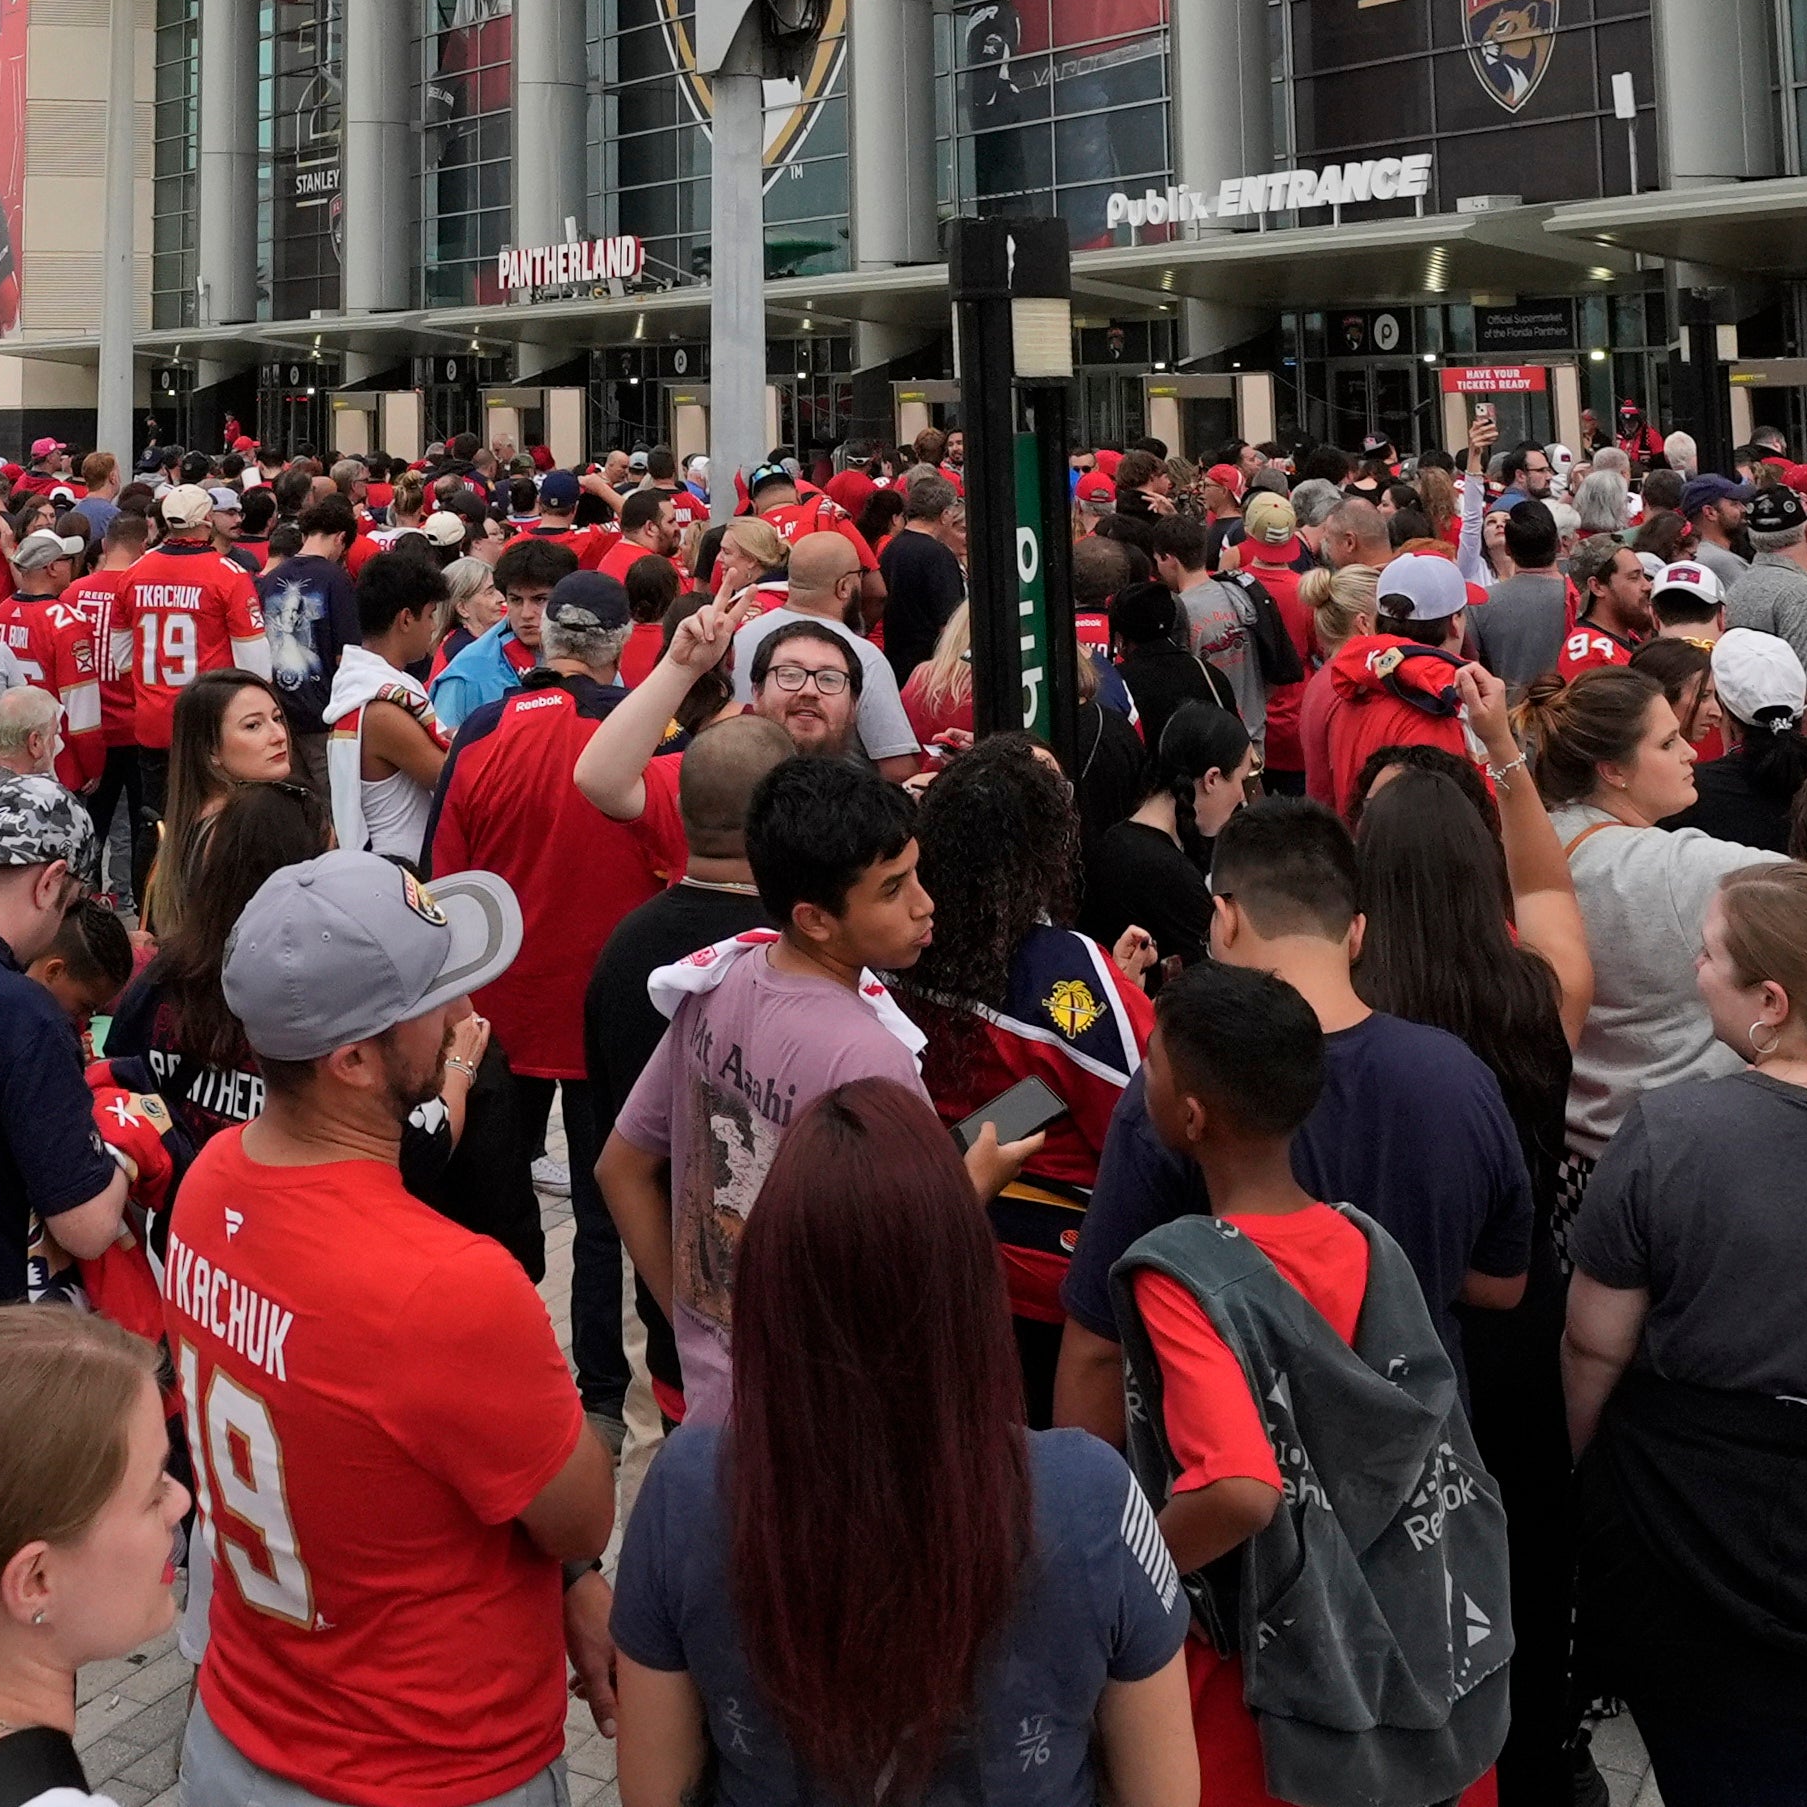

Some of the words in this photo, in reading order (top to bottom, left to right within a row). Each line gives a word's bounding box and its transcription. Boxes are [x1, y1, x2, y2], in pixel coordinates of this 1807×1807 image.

[296, 168, 340, 193] STANLEY
[1217, 154, 1432, 217] ENTRANCE
[498, 235, 638, 289] PANTHERLAND
[1484, 327, 1493, 338] of
[1494, 327, 1506, 338] the
[1507, 326, 1532, 337] Florida
[1534, 325, 1568, 337] Panthers
[1487, 314, 1512, 325] Official
[1514, 313, 1562, 326] Supermarket
[1457, 380, 1496, 391] TICKETS
[1499, 379, 1531, 390] READY
[1466, 370, 1491, 380] HAVE
[1494, 369, 1520, 379] YOUR
[135, 585, 203, 610] TKACHUK
[1076, 619, 1102, 628] eebok
[138, 612, 197, 686] 19
[1567, 633, 1614, 661] 94
[516, 695, 564, 712] Reebok
[719, 1044, 797, 1128] Asahi
[165, 1230, 294, 1382] TKACHUK
[179, 1335, 316, 1632] 19
